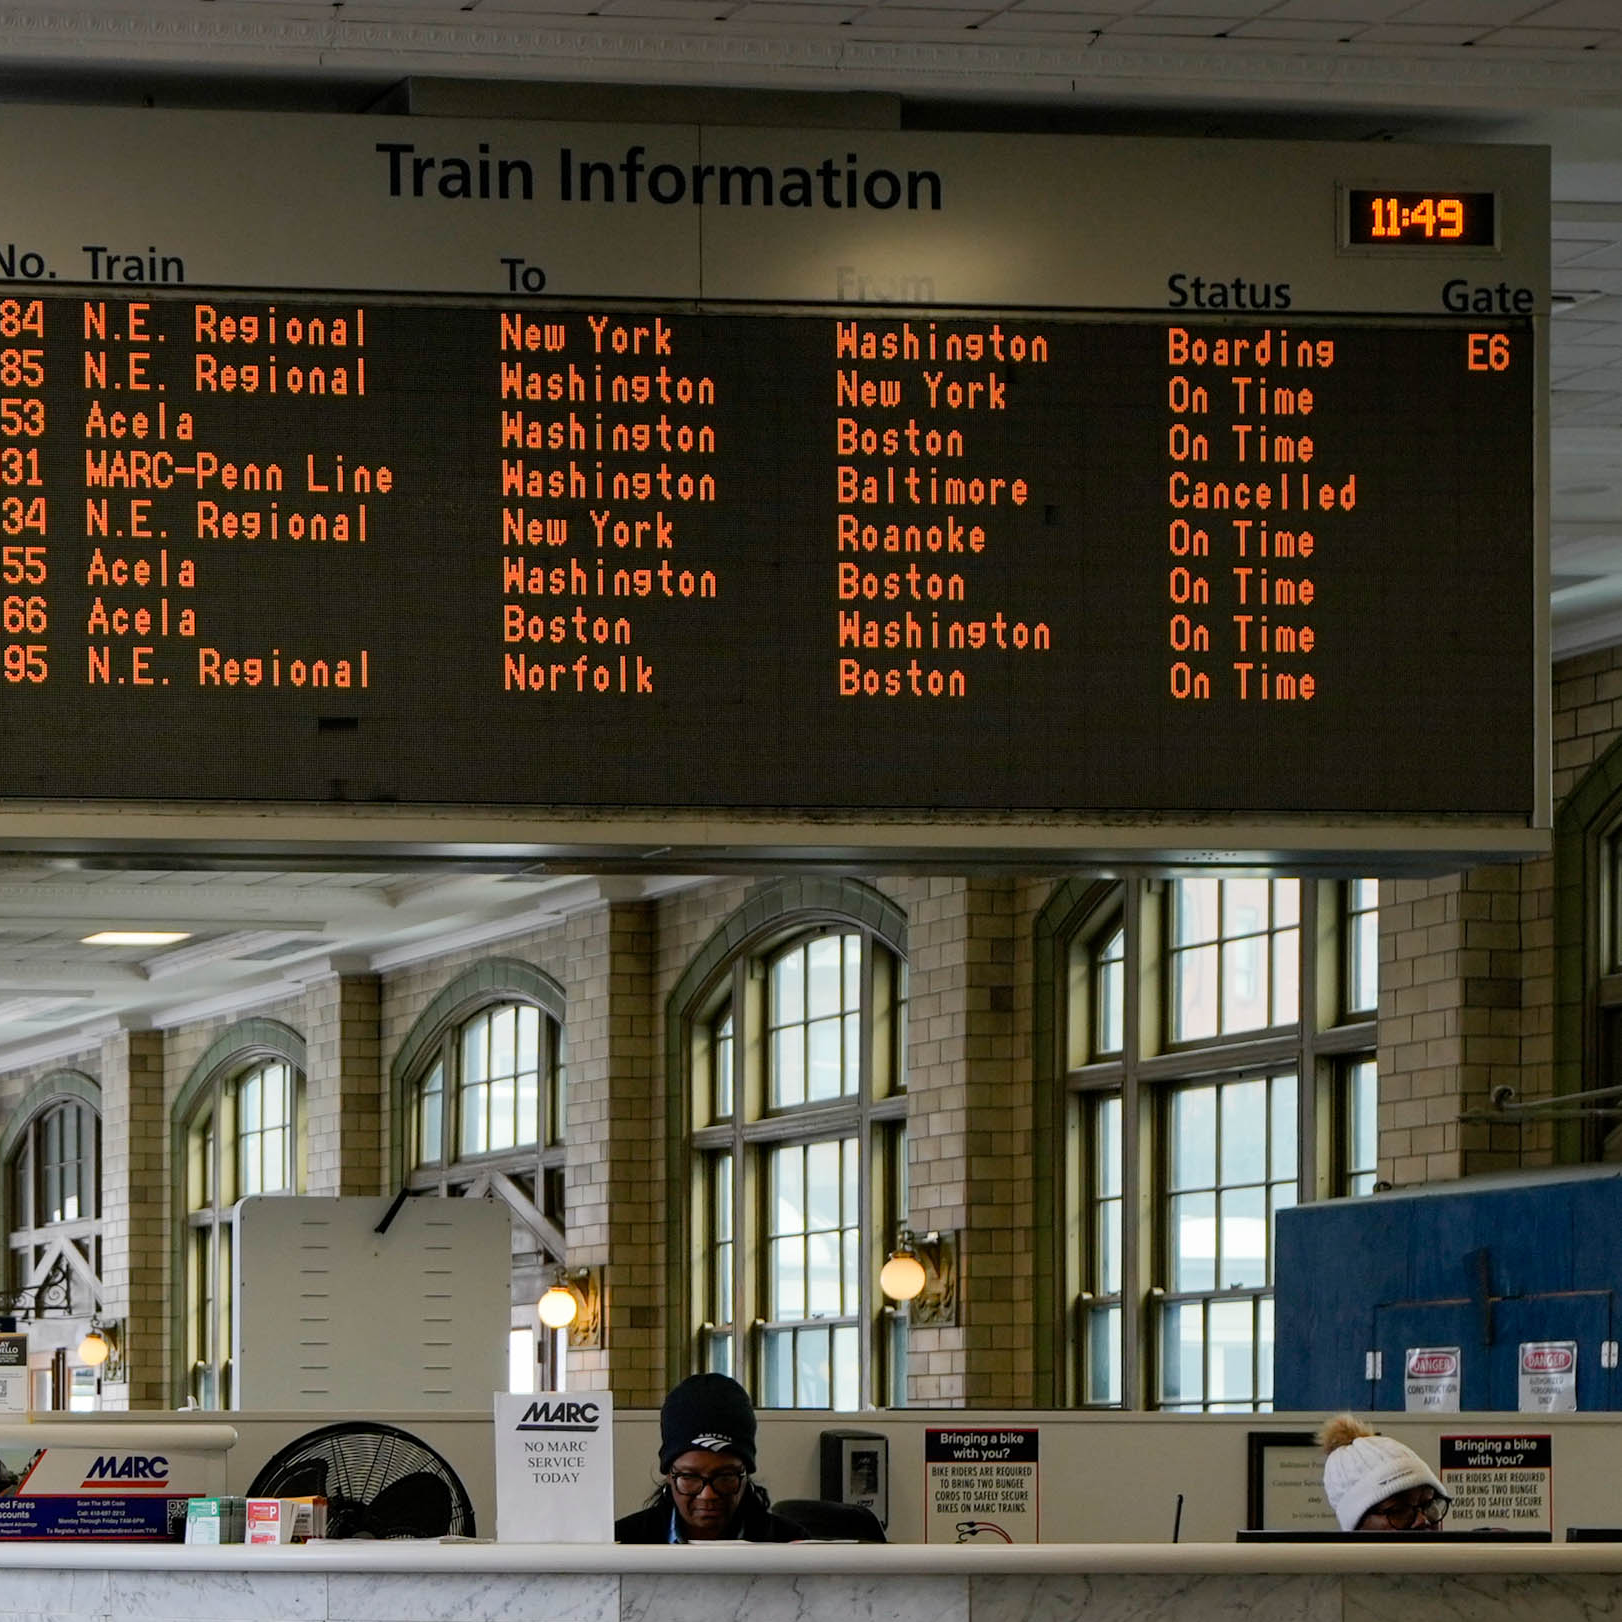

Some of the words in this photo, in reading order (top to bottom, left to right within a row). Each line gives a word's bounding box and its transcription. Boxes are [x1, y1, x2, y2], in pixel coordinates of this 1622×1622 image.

[375, 142, 534, 201] Train
[560, 146, 942, 211] Information
[1370, 197, 1465, 239] 11:49
[82, 245, 185, 283] Train
[500, 258, 547, 293] To
[1167, 273, 1291, 310] Status
[1441, 279, 1535, 314] Gate
[83, 300, 166, 343] N.E.
[194, 303, 365, 348] Regional
[499, 312, 567, 353] New
[586, 314, 673, 356] York
[835, 320, 1049, 364] Washington
[1167, 326, 1335, 369] Boarding
[1467, 332, 1511, 372] E6
[83, 350, 166, 392] N.E.
[194, 352, 366, 397] Regional
[500, 360, 716, 406] Washington
[836, 368, 902, 409] New
[922, 370, 1007, 410] York
[1168, 374, 1209, 415] On
[1230, 375, 1315, 416] Time
[84, 399, 194, 442] Acela
[500, 409, 716, 454] Washington
[836, 416, 964, 458] Boston
[1168, 422, 1209, 462] On
[1231, 423, 1315, 464] Time
[84, 448, 284, 492] MARC-Penn
[306, 453, 394, 495] Line
[501, 458, 716, 502] Washington
[836, 464, 1029, 506] Baltimore
[1168, 470, 1357, 512] Cancelled
[85, 497, 168, 539] N.E.
[196, 499, 367, 543] Regional
[501, 506, 569, 547] New
[588, 508, 674, 550] York
[837, 513, 986, 554] Roanoke
[1168, 518, 1210, 558] On
[1231, 518, 1315, 559] Time
[86, 546, 196, 589] Acela
[502, 555, 718, 599] Washington
[837, 561, 966, 602] Boston
[1168, 565, 1210, 605] On
[1232, 566, 1315, 607] Time
[86, 595, 197, 638] Acela
[503, 603, 632, 646] Boston
[838, 609, 1051, 651] Washington
[1169, 613, 1210, 653] On
[1232, 614, 1316, 654] Time
[2, 643, 49, 685] 95
[87, 644, 170, 686] N.E.
[198, 646, 369, 689] Regional
[503, 652, 654, 694] Norfolk
[838, 657, 966, 698] Boston
[1169, 660, 1211, 700] On
[1232, 661, 1316, 701] Time
[1413, 1357, 1451, 1371] DANGER
[1528, 1352, 1566, 1367] DANGER
[520, 1401, 600, 1424] MARC
[940, 1432, 988, 1446] Bringing
[990, 1435, 997, 1444] a
[999, 1432, 1024, 1445] bike
[1454, 1439, 1502, 1453] Bringing
[1504, 1441, 1511, 1450] a
[1513, 1438, 1537, 1450] bike
[524, 1441, 545, 1453] NO
[547, 1441, 588, 1453] MARC
[953, 1447, 979, 1459] with
[981, 1447, 1011, 1461] you?
[85, 1455, 169, 1479] MARC
[527, 1456, 586, 1468] SERVICE
[1467, 1454, 1493, 1465] with
[1495, 1453, 1524, 1467] you?
[532, 1472, 581, 1484] TODAY
[931, 1466, 949, 1477] BIKE
[950, 1466, 977, 1477] RIDERS
[979, 1466, 994, 1477] ARE
[996, 1466, 1032, 1477] REQUIRED
[940, 1478, 950, 1489] TO
[951, 1478, 975, 1489] BRING
[977, 1478, 994, 1489] TWO
[995, 1478, 1024, 1489] BUNGEE
[935, 1490, 961, 1501] CORDS
[962, 1490, 972, 1501] TO
[973, 1490, 998, 1501] SAFELY
[1000, 1490, 1028, 1501] SECURE
[12, 1500, 36, 1509] Fares
[937, 1502, 958, 1513] BIKES
[960, 1502, 972, 1513] ON
[973, 1502, 996, 1513] MARC
[998, 1502, 1026, 1513] TRAINS.
